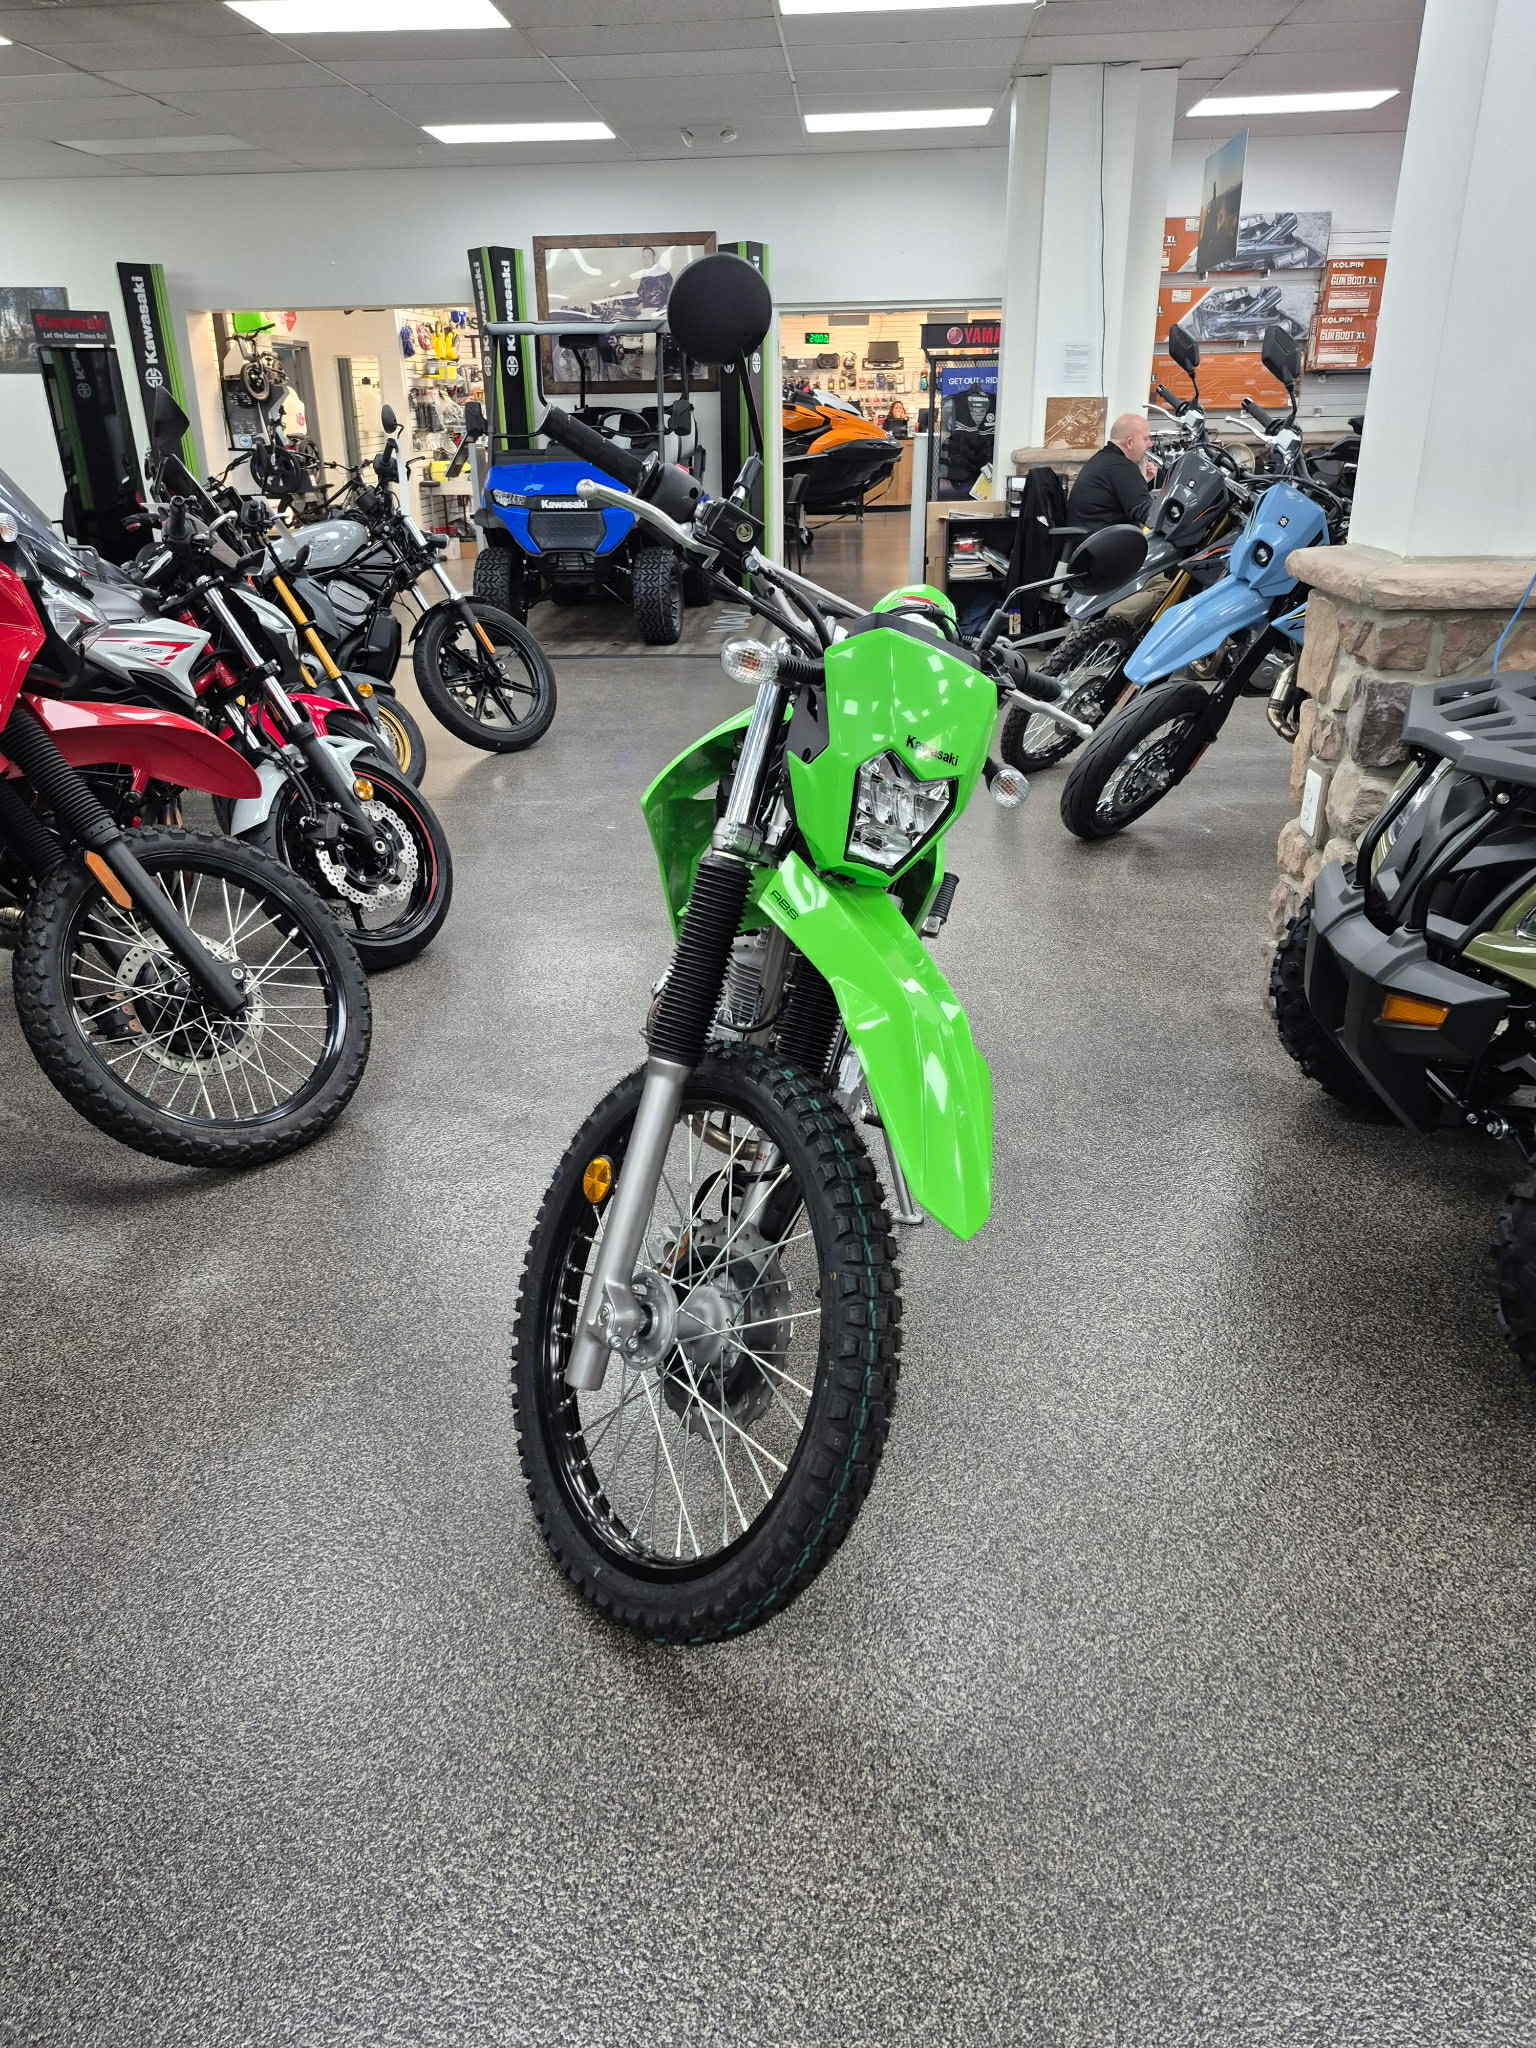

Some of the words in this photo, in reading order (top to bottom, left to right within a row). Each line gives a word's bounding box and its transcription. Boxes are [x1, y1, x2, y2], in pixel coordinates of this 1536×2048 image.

[1347, 276, 1366, 285] BOOT
[1368, 276, 1377, 284] XL
[131, 275, 158, 364] Kawasaki
[473, 261, 490, 352] Kwasaki
[501, 260, 516, 352] Kwasaki
[964, 327, 1000, 344] YAMA
[1335, 331, 1355, 340] BOOT
[1356, 331, 1366, 339] XL
[541, 499, 588, 509] Kawasaki
[906, 735, 960, 767] Kaasaki
[771, 890, 799, 920] ABS
